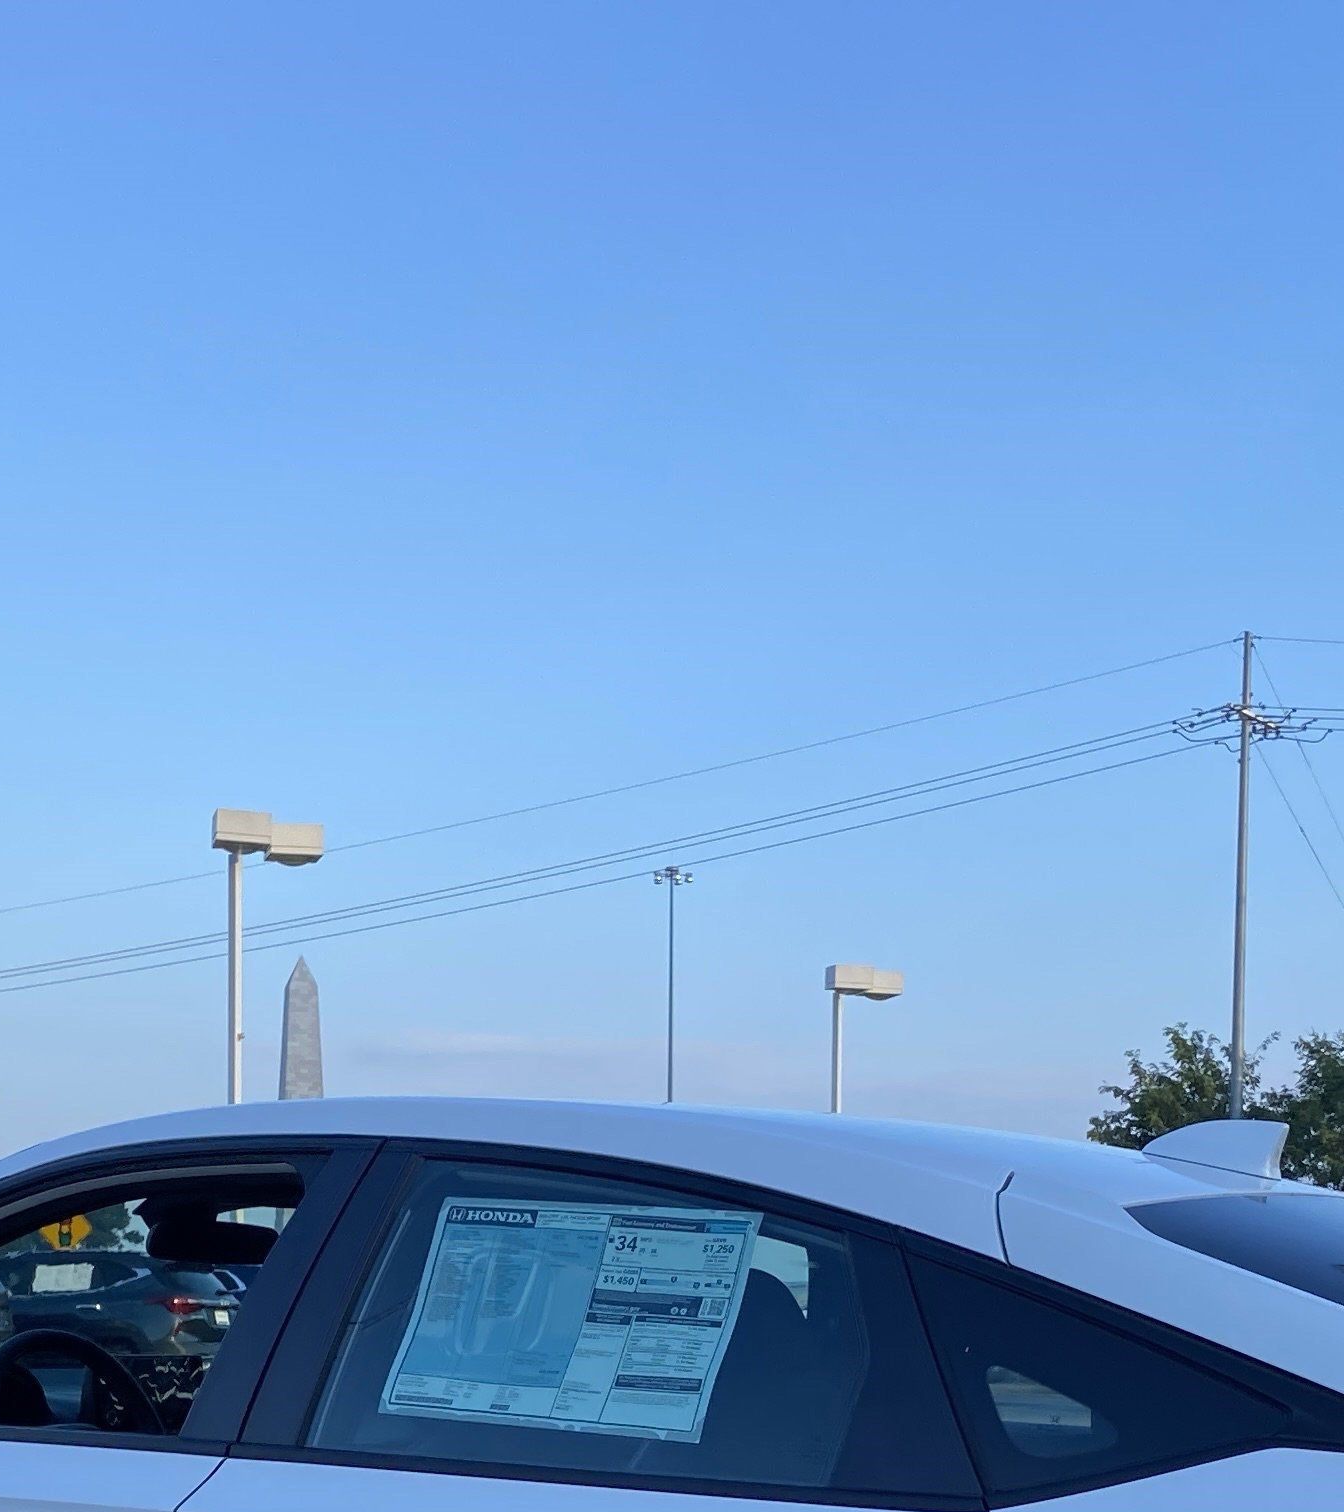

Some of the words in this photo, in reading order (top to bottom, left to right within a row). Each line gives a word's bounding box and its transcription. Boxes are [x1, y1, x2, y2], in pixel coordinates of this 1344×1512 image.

[465, 1209, 535, 1224] HONDA
[614, 1235, 638, 1252] 34
[702, 1244, 735, 1255] $1,250
[602, 1274, 635, 1286] $1,450
